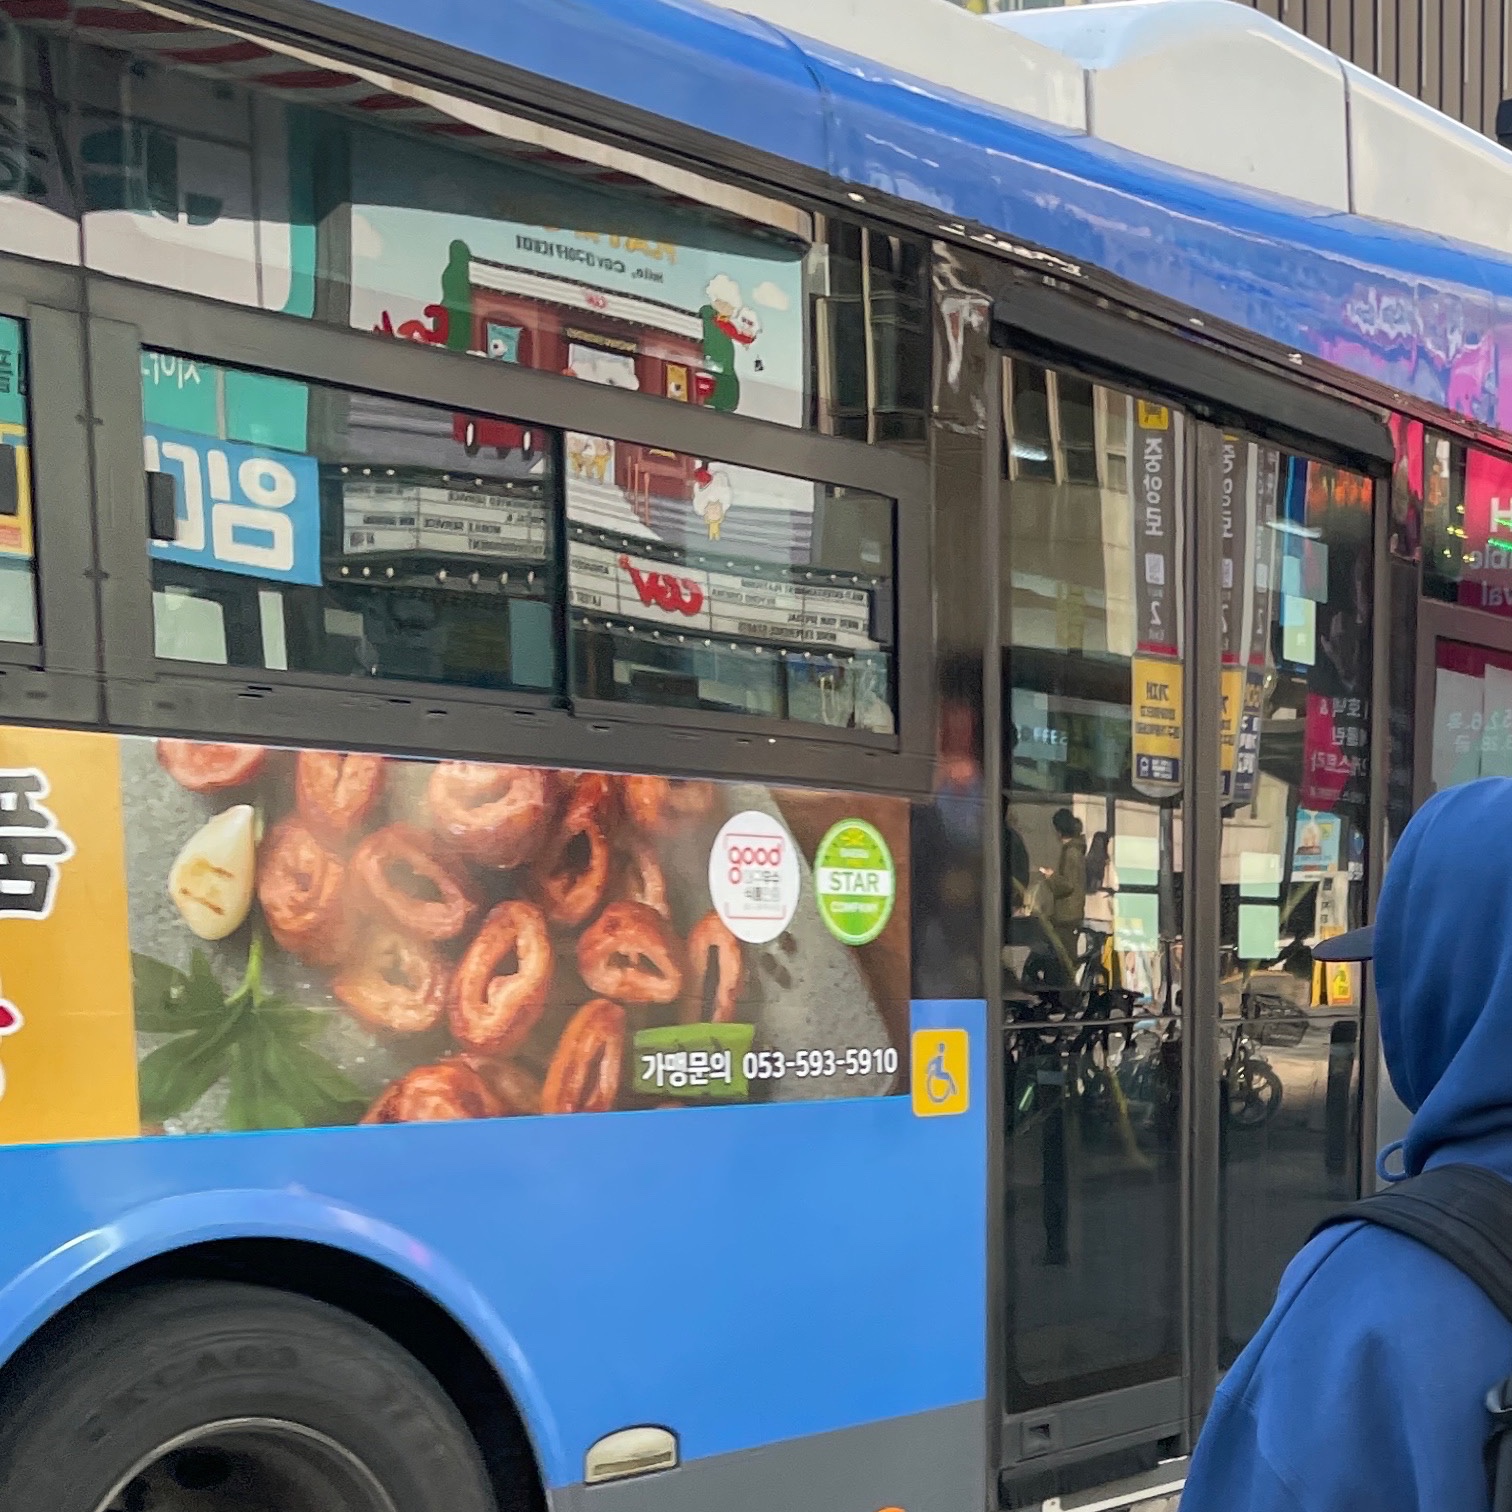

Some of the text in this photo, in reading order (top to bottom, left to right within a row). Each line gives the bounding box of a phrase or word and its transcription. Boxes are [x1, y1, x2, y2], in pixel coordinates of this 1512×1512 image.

[728, 844, 783, 885] good
[830, 870, 880, 893] STAR
[641, 1047, 899, 1088] 가맹문의 053-593-5910
